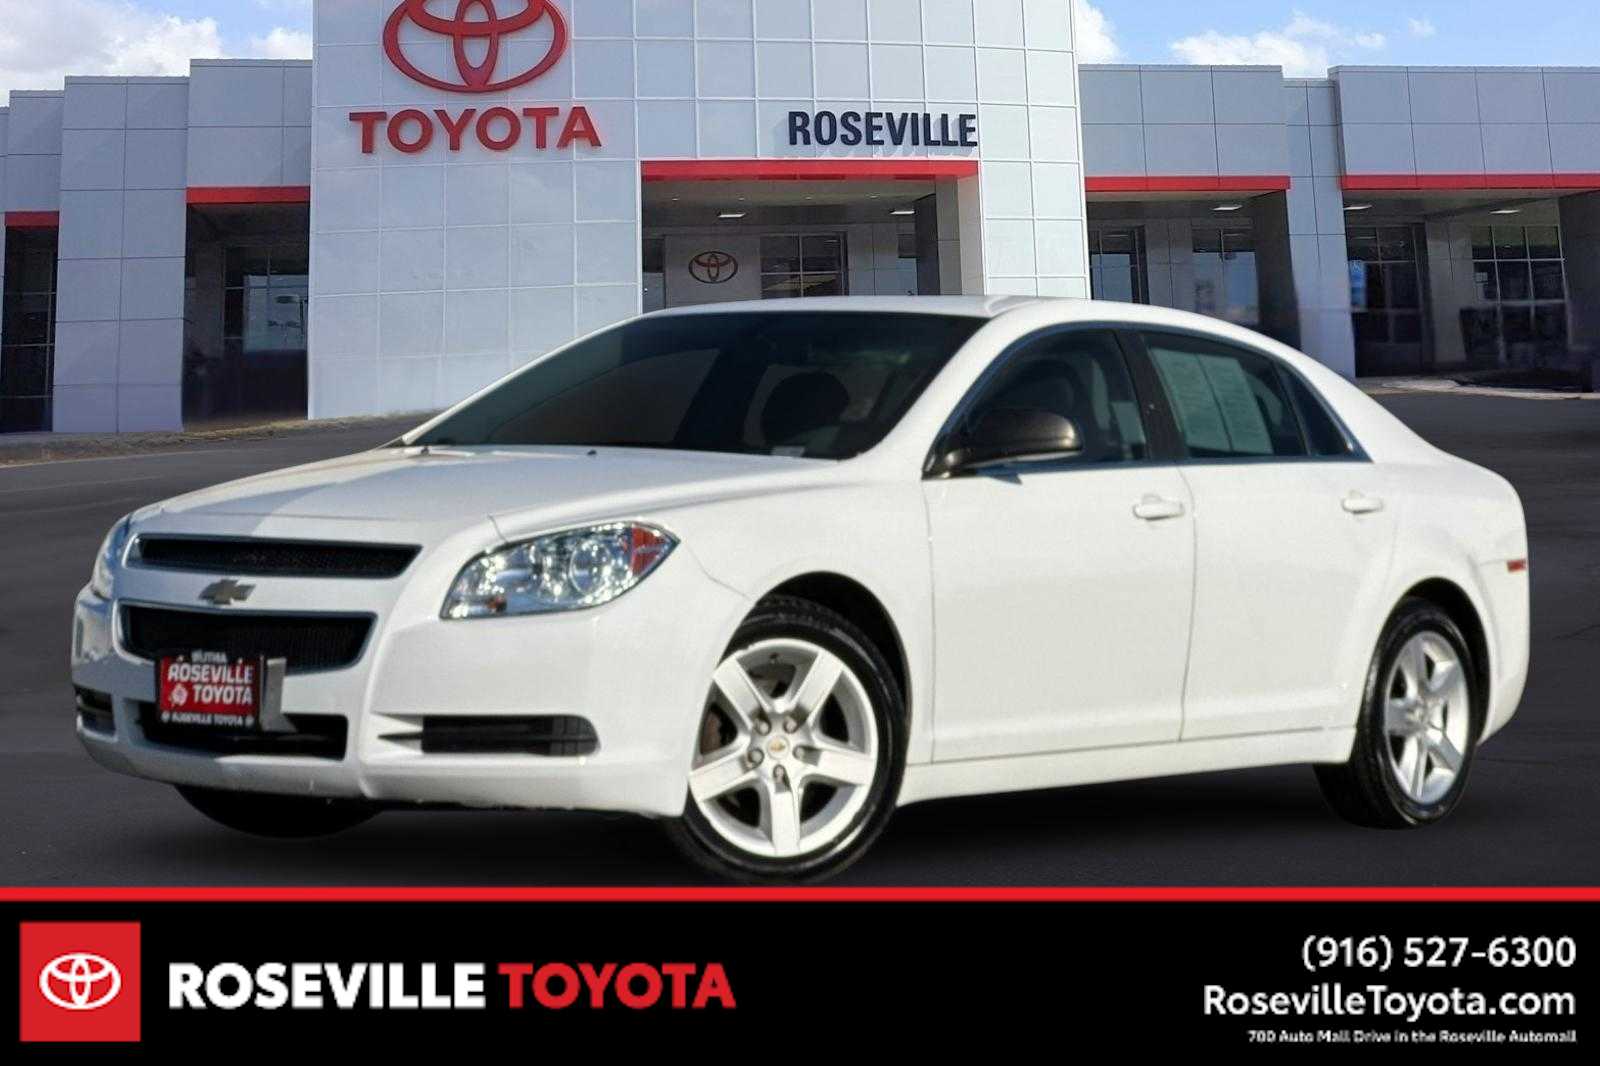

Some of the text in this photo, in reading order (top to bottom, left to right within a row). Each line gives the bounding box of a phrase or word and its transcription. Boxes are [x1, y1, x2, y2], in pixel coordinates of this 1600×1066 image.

[348, 106, 603, 154] TOYOTA
[788, 111, 979, 148] ROSEVILLE
[168, 663, 253, 684] ROSEVILLE
[193, 684, 253, 705] TOYOTA
